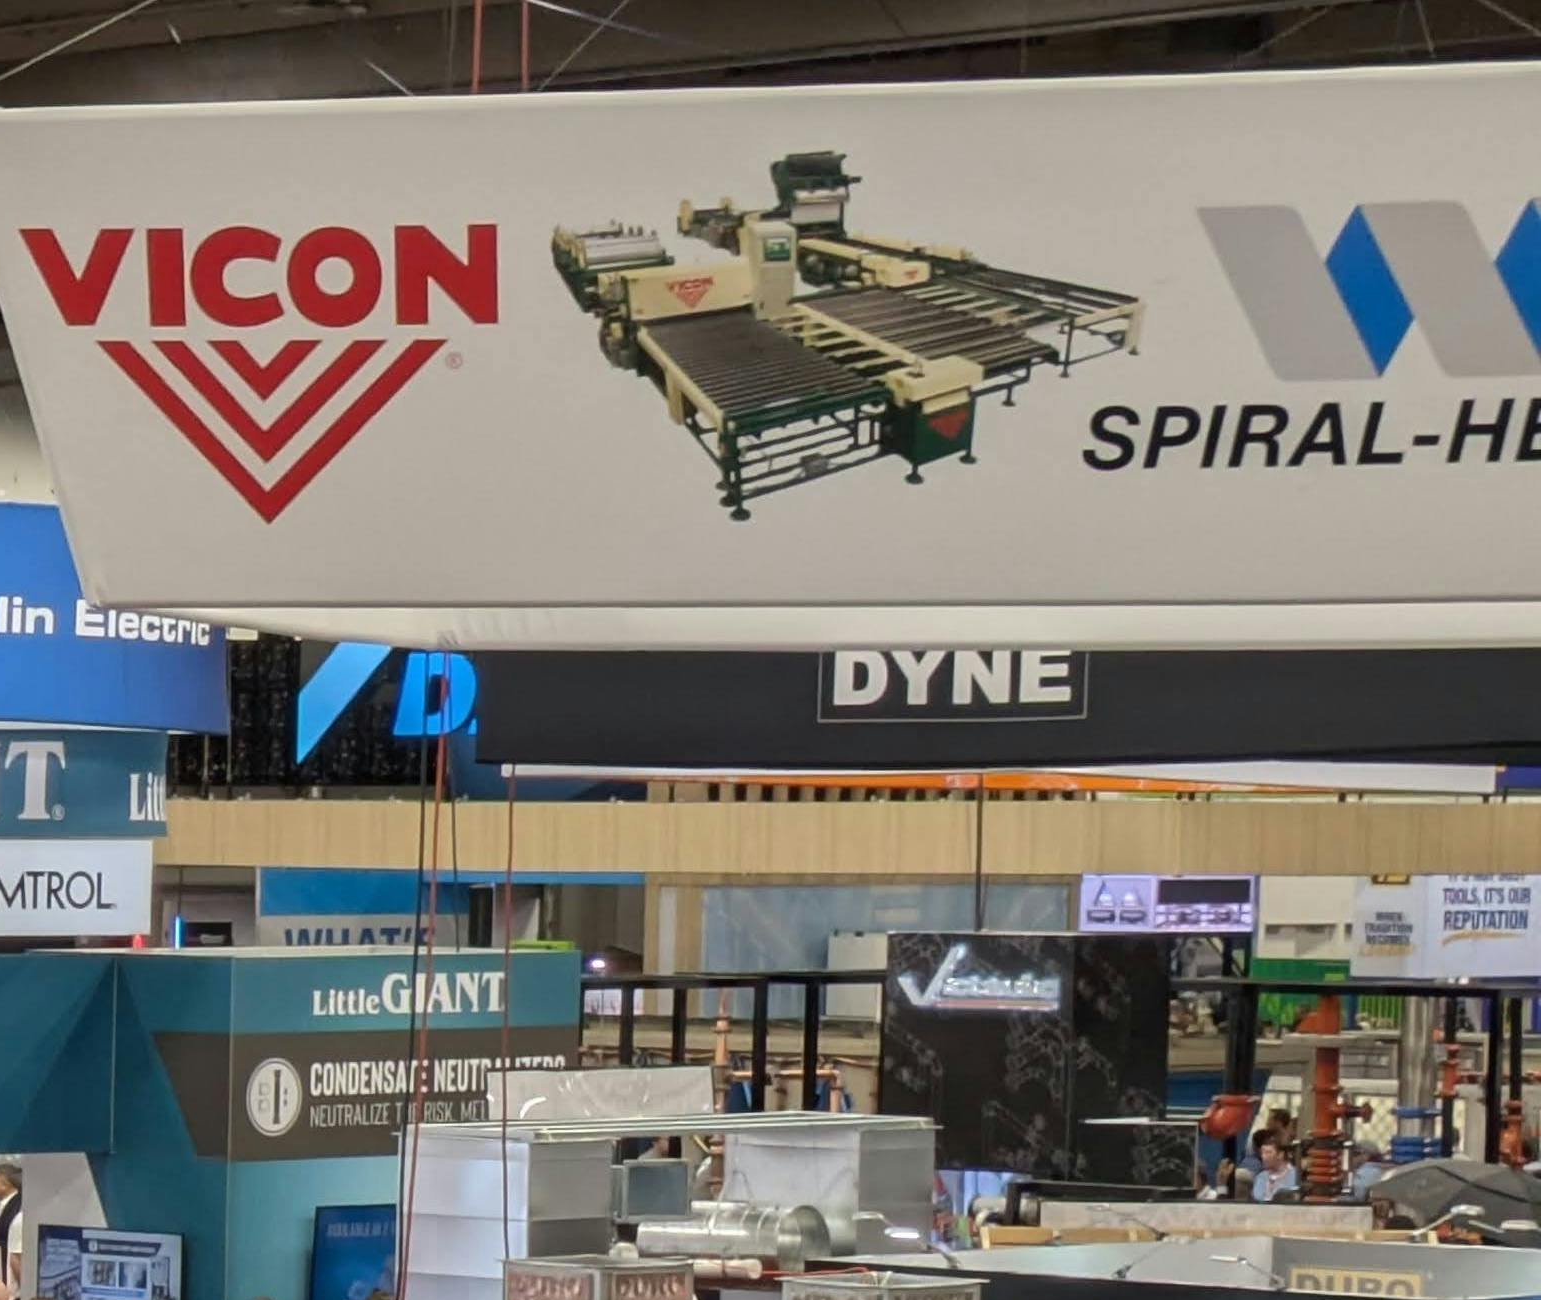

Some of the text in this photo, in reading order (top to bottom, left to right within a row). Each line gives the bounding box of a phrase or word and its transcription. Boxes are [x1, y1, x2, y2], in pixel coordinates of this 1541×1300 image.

[18, 223, 499, 328] VICON
[75, 600, 211, 650] Electric
[832, 650, 1072, 706] DYNE
[311, 970, 506, 1016] Little GIANT
[309, 1057, 430, 1097] CONDENSAT
